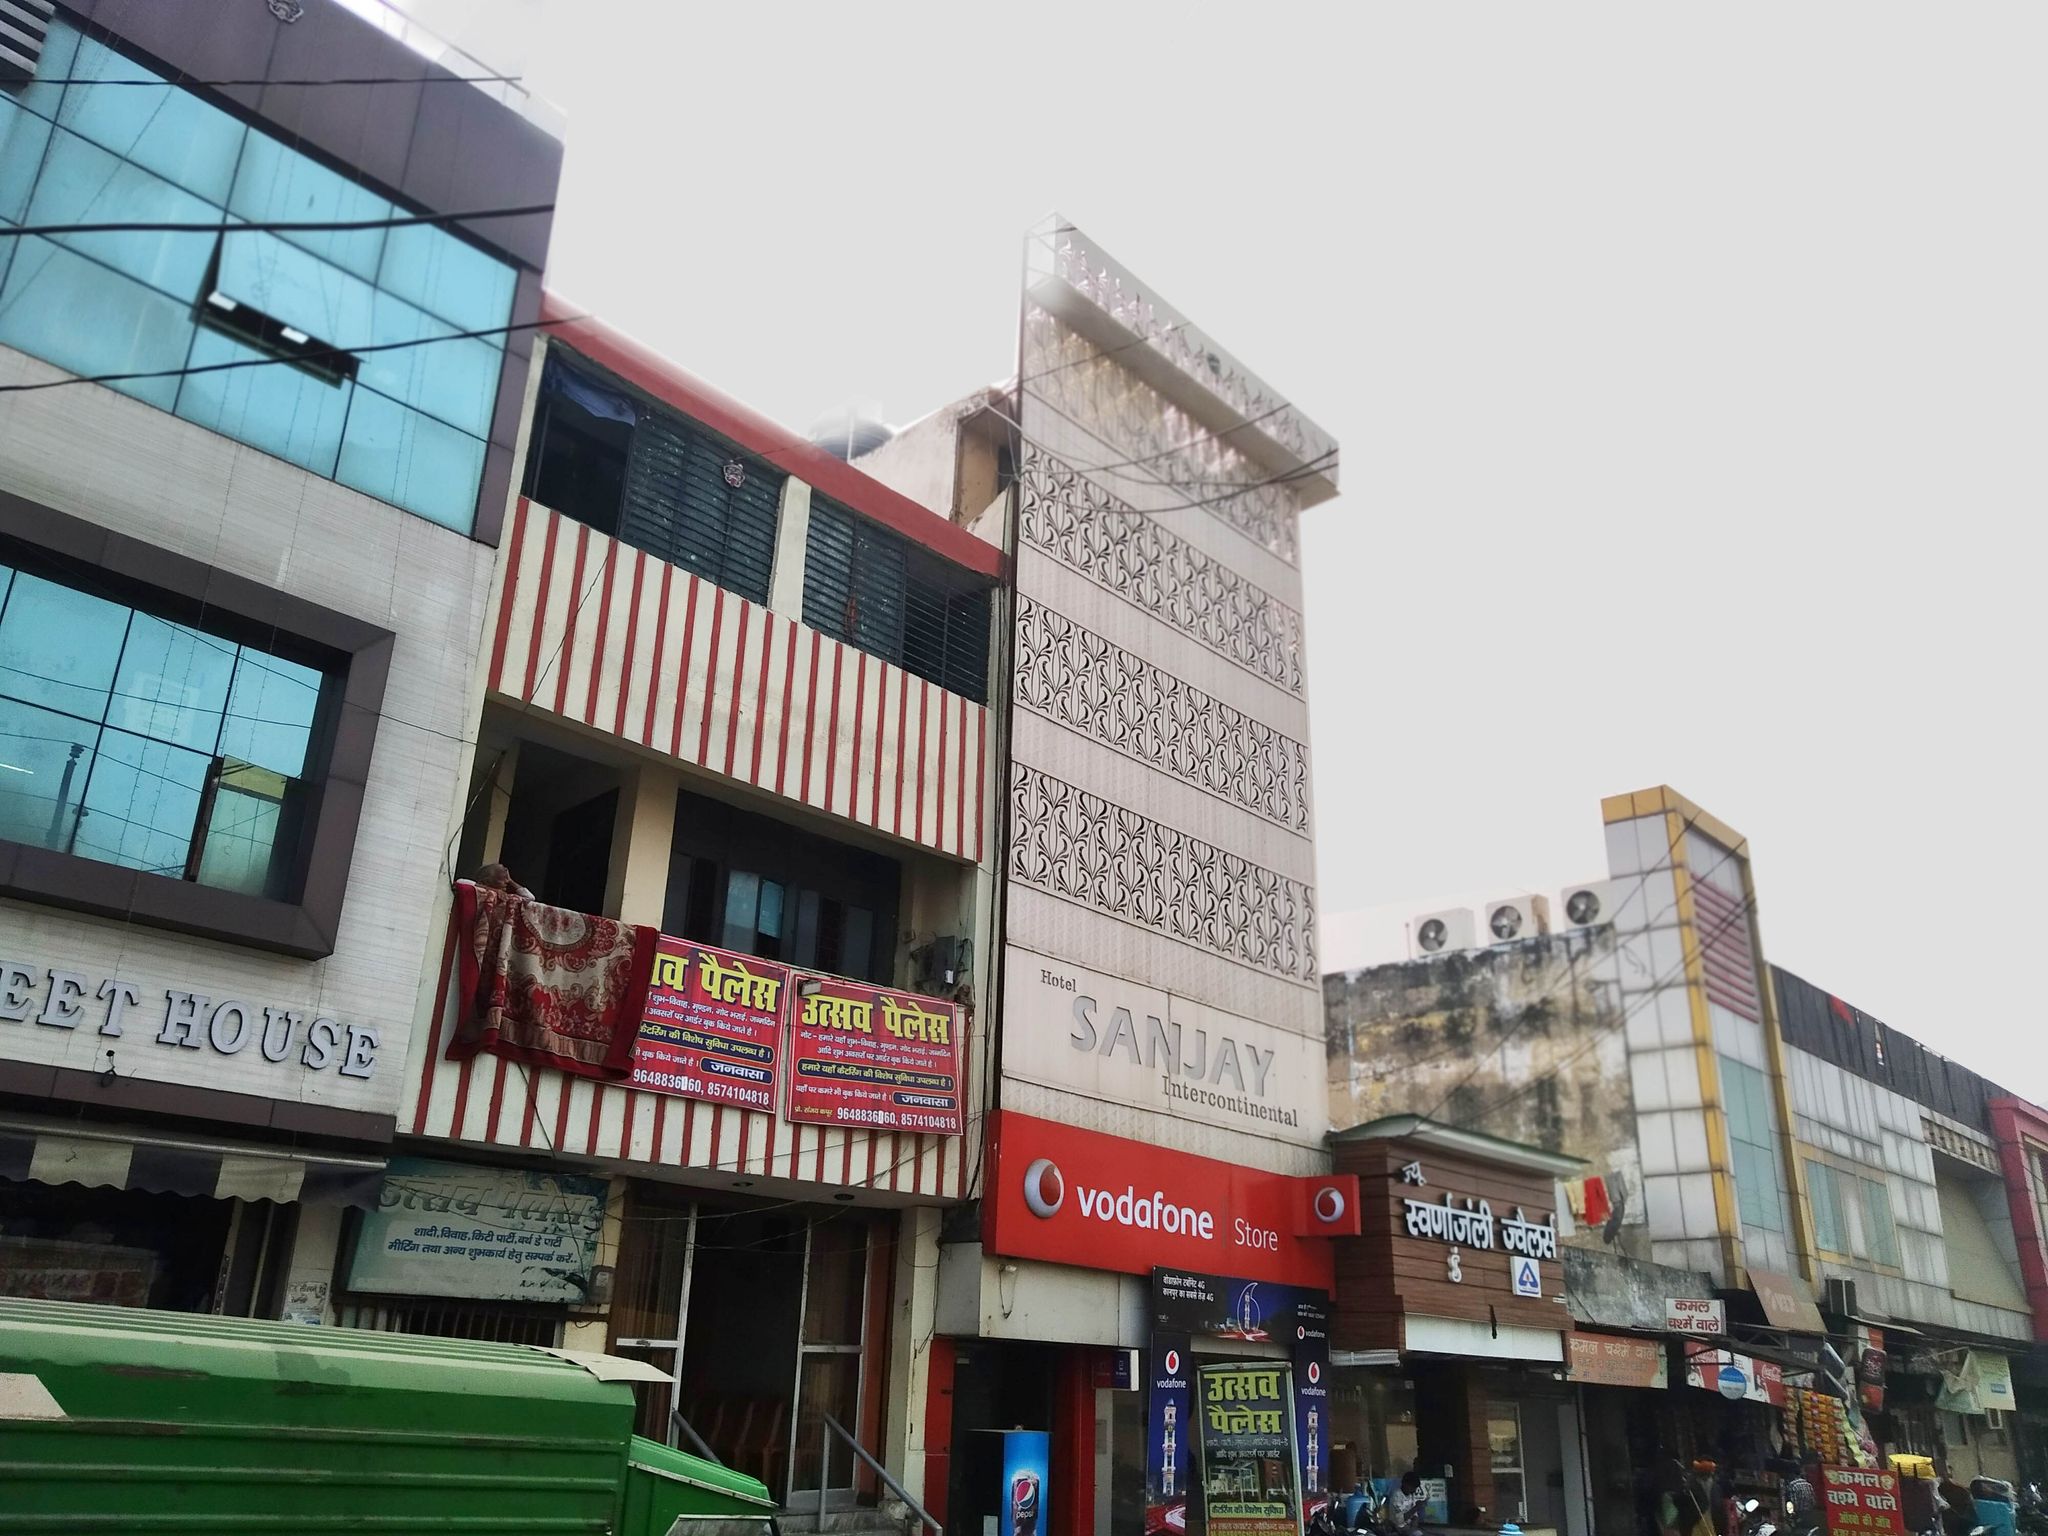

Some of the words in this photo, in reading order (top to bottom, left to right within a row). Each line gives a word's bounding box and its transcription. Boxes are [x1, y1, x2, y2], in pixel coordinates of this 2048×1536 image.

[698, 952, 780, 1012] पैलेस
[1040, 969, 1077, 993] Hotel
[674, 1012, 684, 1021] पर
[801, 994, 874, 1033] उत्सव
[880, 996, 950, 1045] पैलेस
[156, 988, 380, 1079] HOUSE
[668, 1030, 680, 1040] की
[682, 1032, 703, 1044] विशेष
[705, 1038, 729, 1050] सुविधा
[730, 1043, 757, 1056] उपलब्ध
[1070, 995, 1275, 1098] SANJAY
[642, 1050, 654, 1061] बुक
[655, 1050, 672, 1061] किये
[672, 1054, 688, 1065] जाते
[709, 1060, 766, 1081] जनवासा
[801, 1062, 820, 1072] हमारे
[863, 1068, 875, 1079] की
[894, 1072, 916, 1085] सुविधा
[707, 1082, 770, 1106] 8574104818
[901, 1094, 950, 1108] जनवासा
[1162, 1074, 1299, 1128] Intercontinental
[901, 1114, 957, 1130] 8574104818
[1077, 1185, 1214, 1240] vodafone
[1234, 1217, 1279, 1252] Store
[471, 1228, 494, 1242] किटी
[534, 1232, 542, 1248] डे
[544, 1235, 562, 1248] पार्टी
[388, 1239, 420, 1254] मीटिंग
[421, 1243, 441, 1255] तथा
[443, 1244, 467, 1256] अन्य
[468, 1246, 505, 1262] शुभकार्य
[507, 1248, 523, 1264] हेतु
[524, 1248, 554, 1264] सम्पर्क
[1162, 1287, 1179, 1300] कानपुर
[1178, 1290, 1187, 1299] का
[1206, 1292, 1214, 1302] 4G
[1197, 1280, 1206, 1290] 4G
[1674, 1299, 1711, 1313] कमल
[1667, 1314, 1694, 1330] चश्में
[1696, 1315, 1720, 1333] वाले
[1305, 1330, 1326, 1339] vodafone
[1569, 1337, 1600, 1355] कमल
[1156, 1377, 1187, 1389] vodafone
[1203, 1371, 1281, 1402] उत्सव
[1300, 1386, 1327, 1398] vodafone
[1206, 1404, 1283, 1435] पैलेस
[1837, 1470, 1881, 1488] कमल
[1864, 1492, 1898, 1511] वाले
[1015, 1509, 1034, 1520] pepsi
